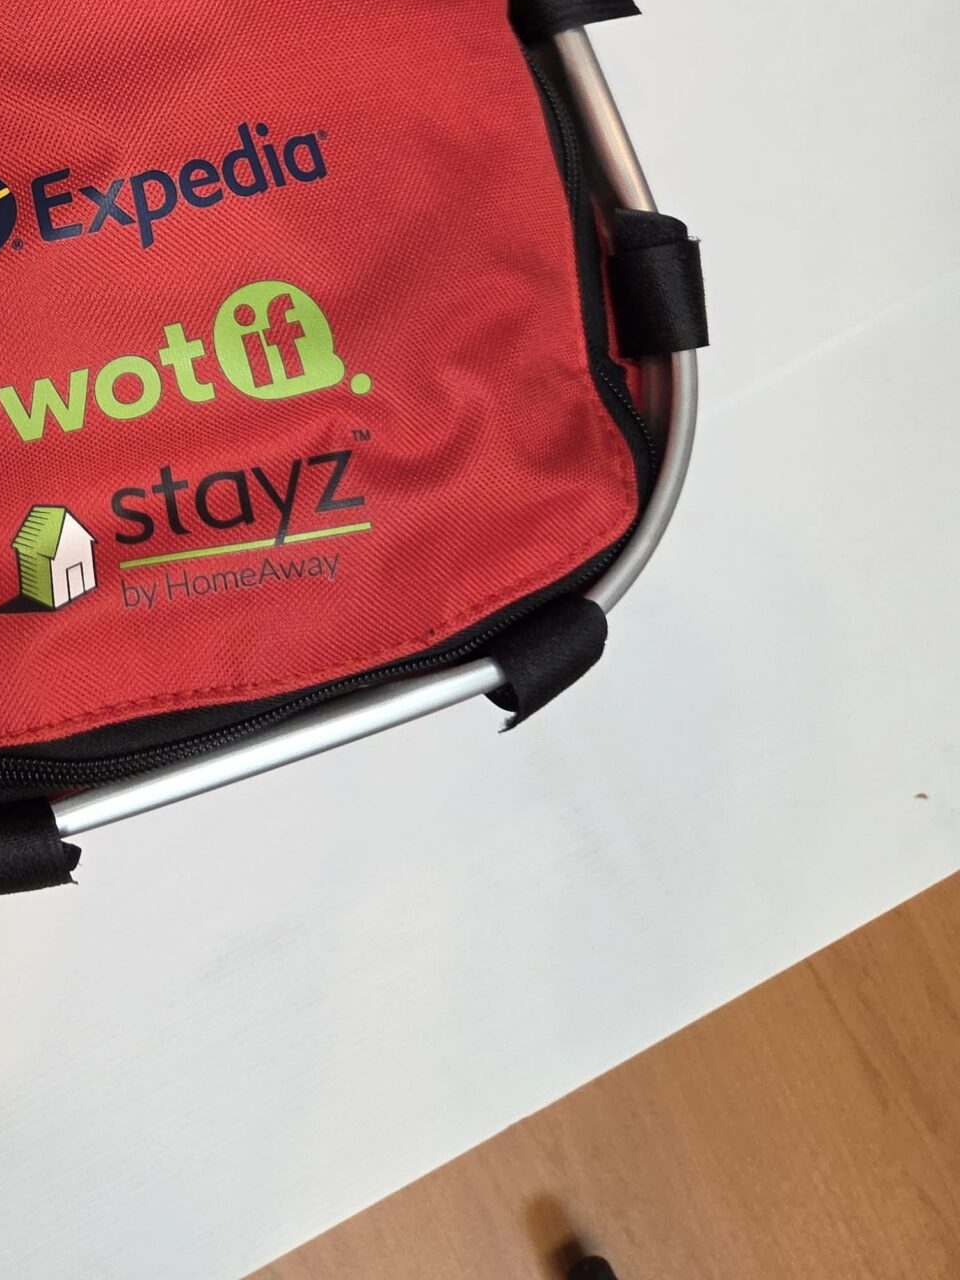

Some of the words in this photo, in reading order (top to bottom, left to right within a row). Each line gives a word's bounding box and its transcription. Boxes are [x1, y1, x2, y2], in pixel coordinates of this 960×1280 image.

[31, 122, 328, 249] Expedia
[111, 449, 365, 546] stayz
[121, 579, 157, 609] by
[165, 553, 339, 600] HomeAway
